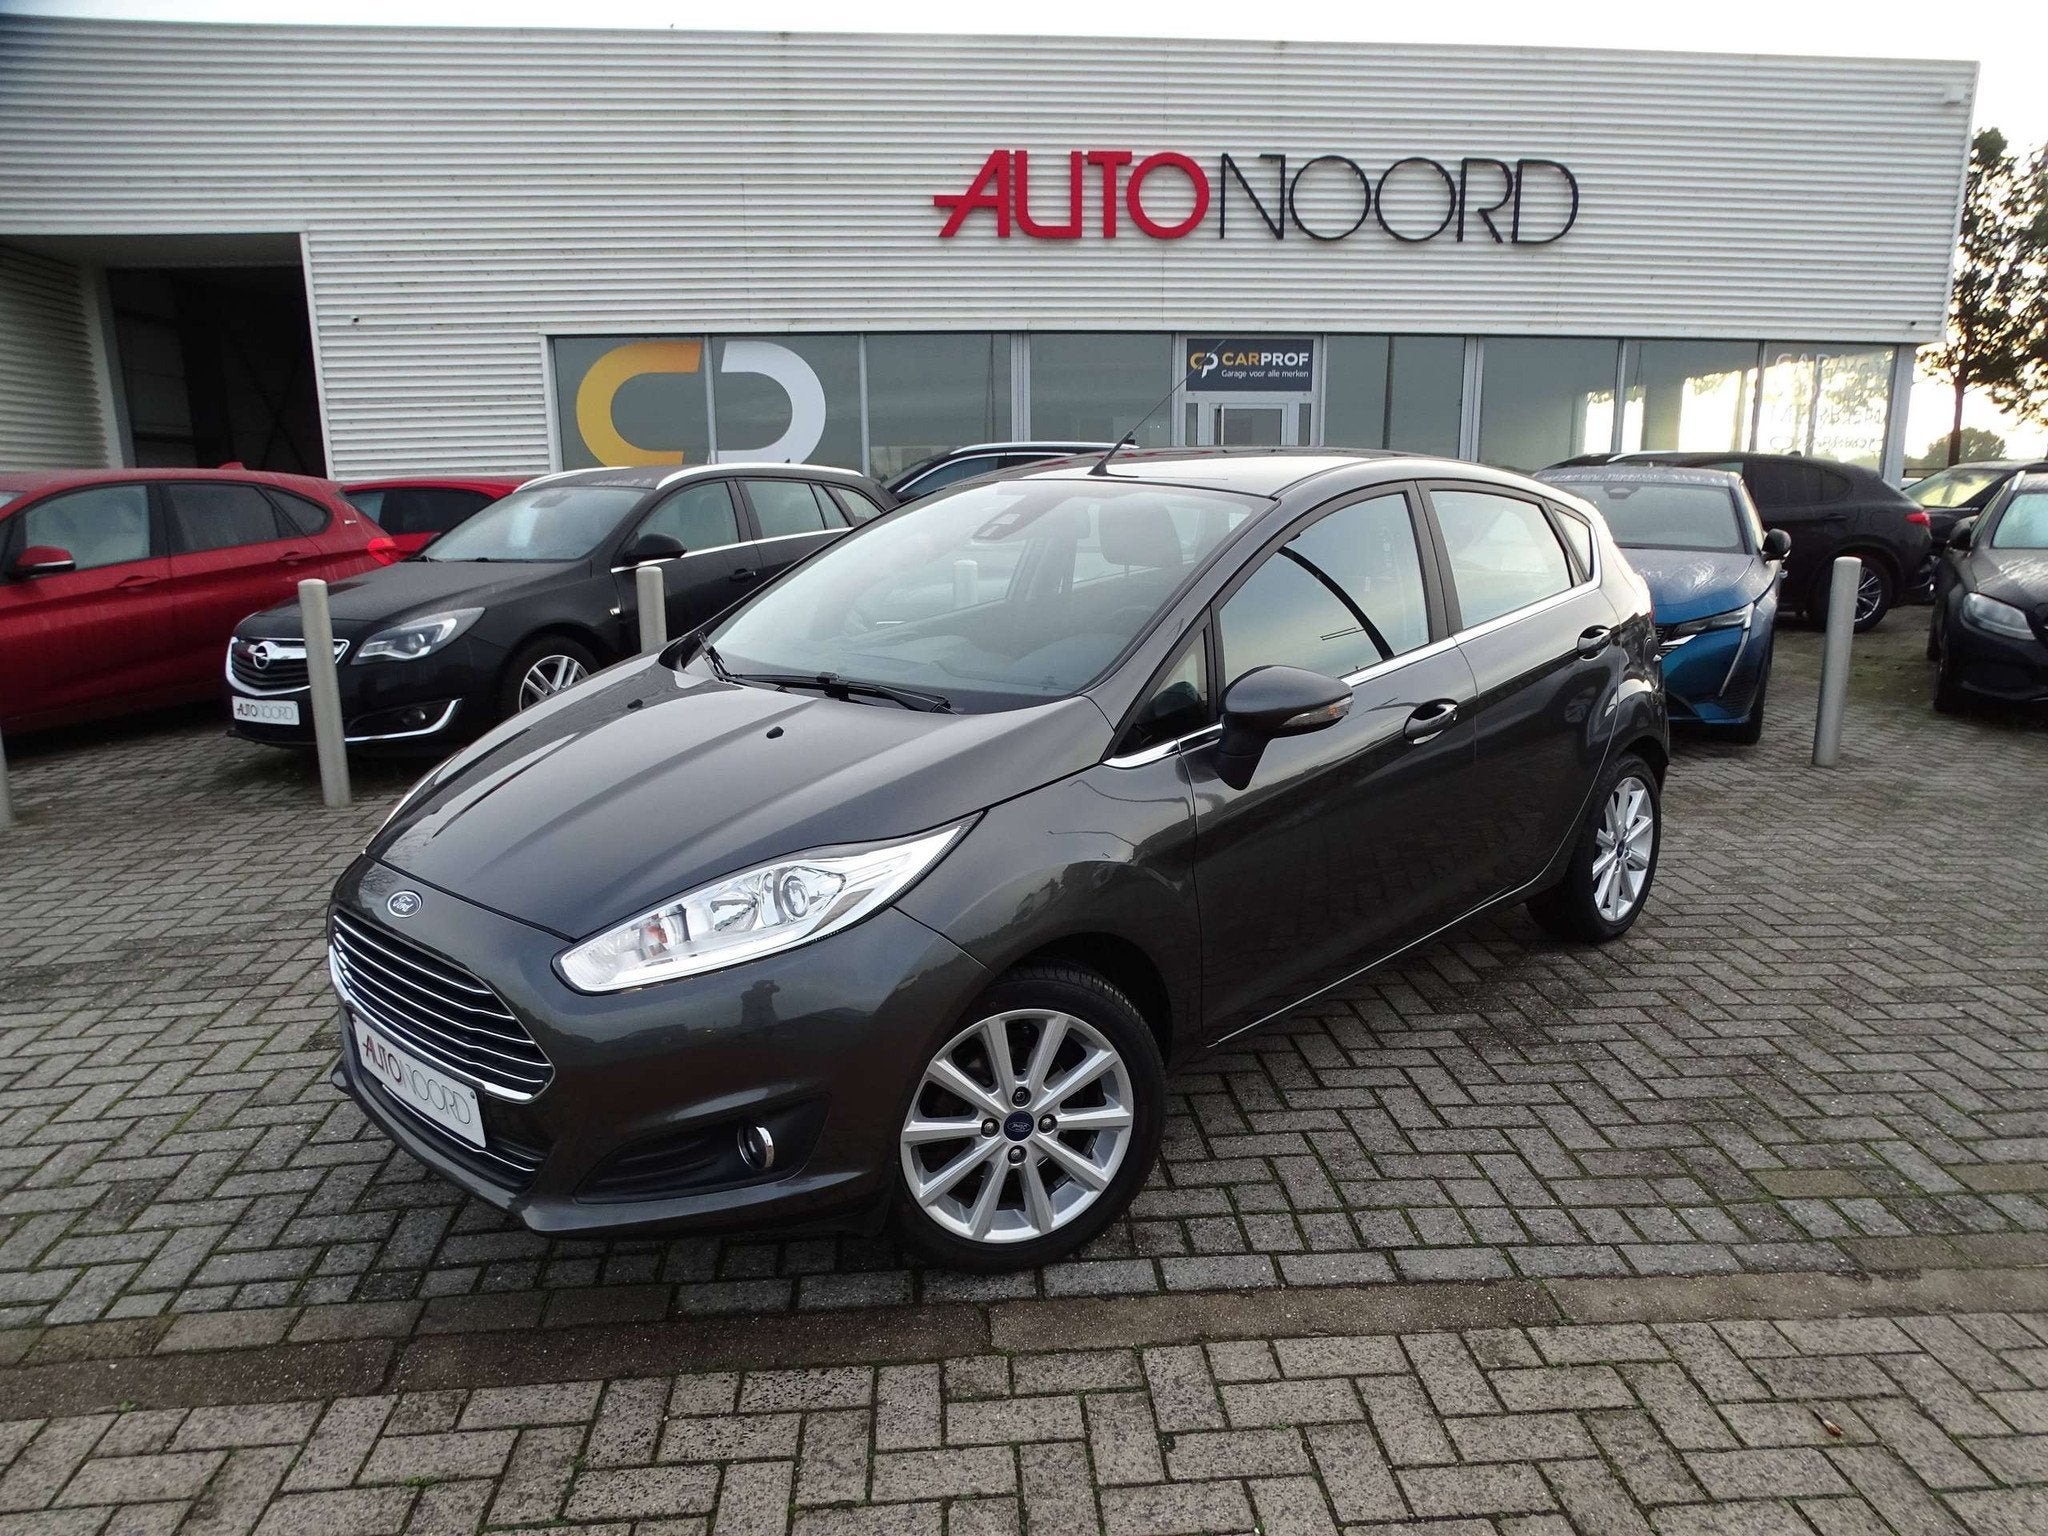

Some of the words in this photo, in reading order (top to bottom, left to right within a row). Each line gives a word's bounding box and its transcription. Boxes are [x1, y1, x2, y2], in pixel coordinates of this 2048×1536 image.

[1221, 352, 1309, 366] CARPROF
[1221, 369, 1247, 379] Garage
[1267, 369, 1280, 378] alle
[1281, 369, 1309, 378] merken
